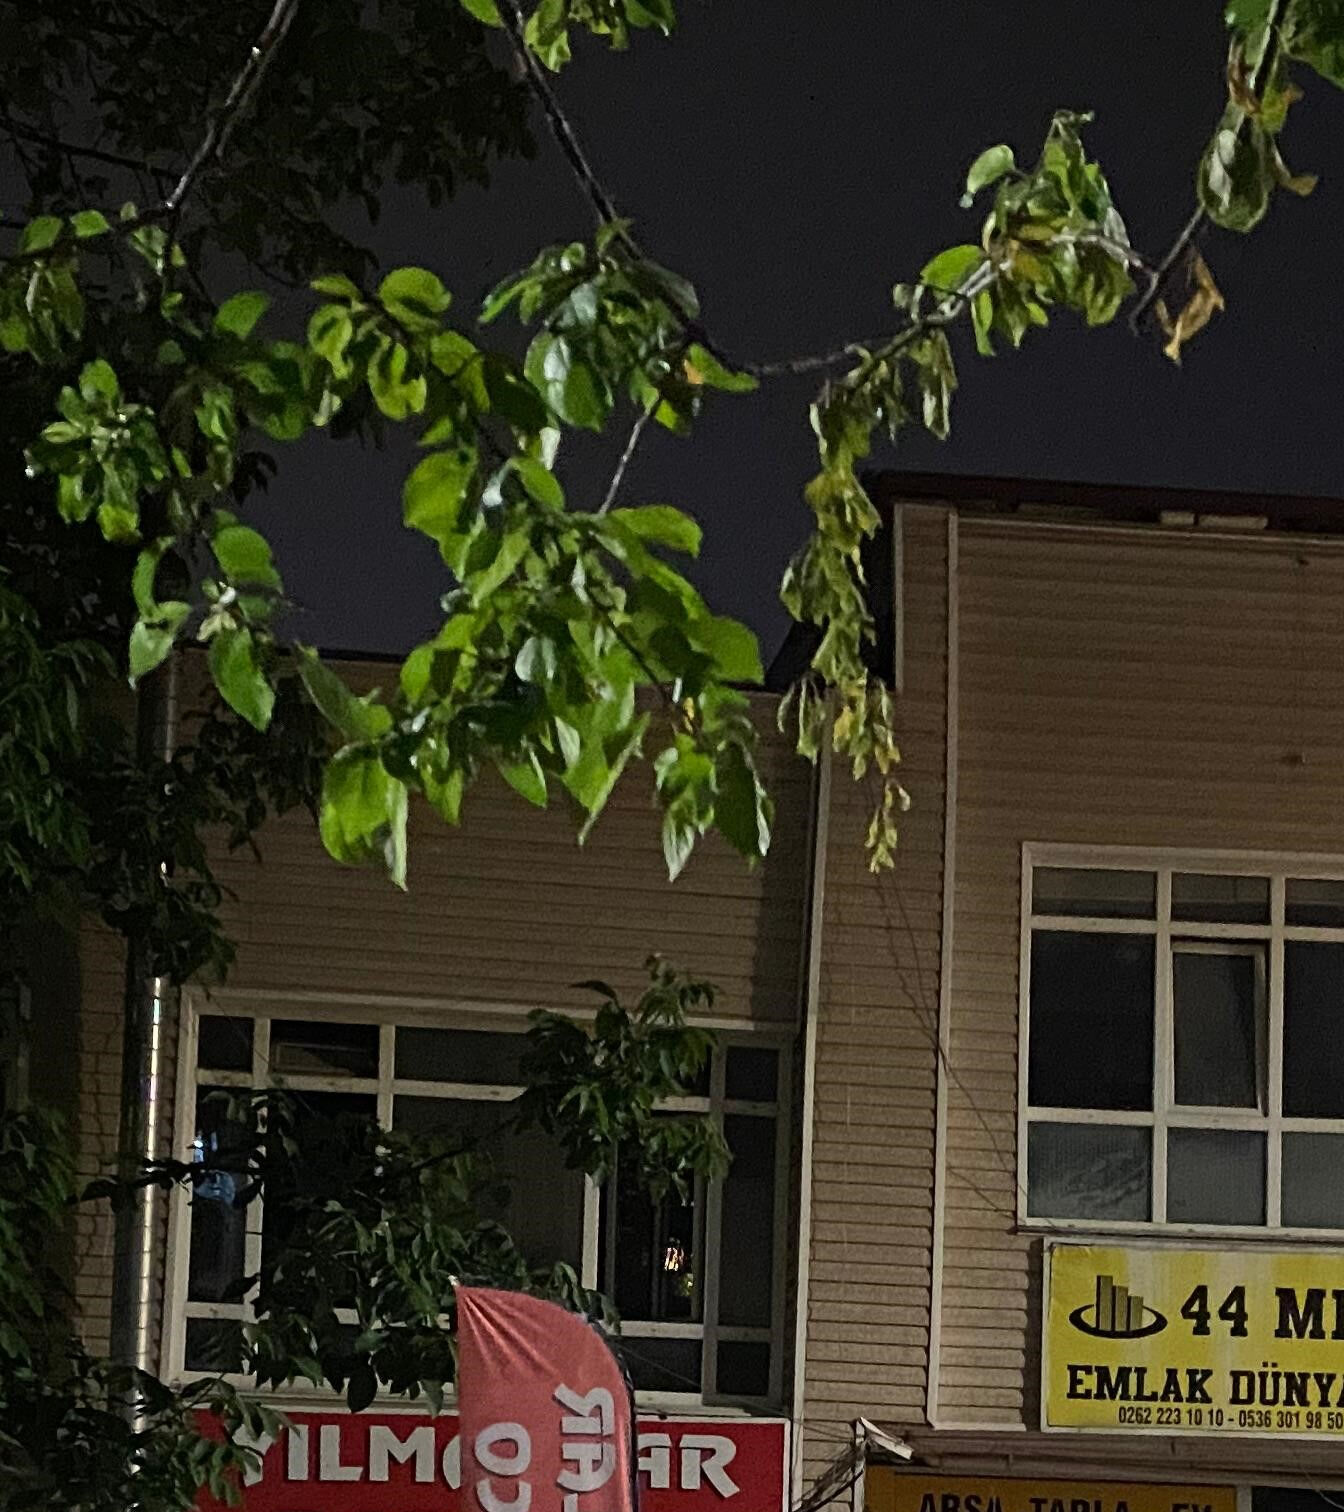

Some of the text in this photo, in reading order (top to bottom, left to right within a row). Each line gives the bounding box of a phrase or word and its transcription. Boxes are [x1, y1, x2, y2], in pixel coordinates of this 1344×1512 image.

[1181, 1285, 1248, 1336] 44
[1067, 1365, 1213, 1403] EMLAK
[1118, 1406, 1152, 1424] 0262
[1157, 1407, 1181, 1425] 223
[1187, 1408, 1202, 1425] 10
[1208, 1409, 1224, 1426] 10
[1238, 1410, 1271, 1428] 0536
[1277, 1411, 1300, 1428] 301
[1306, 1411, 1322, 1429] 98
[1327, 1412, 1344, 1430] 50
[232, 1424, 740, 1498] YILMAR
